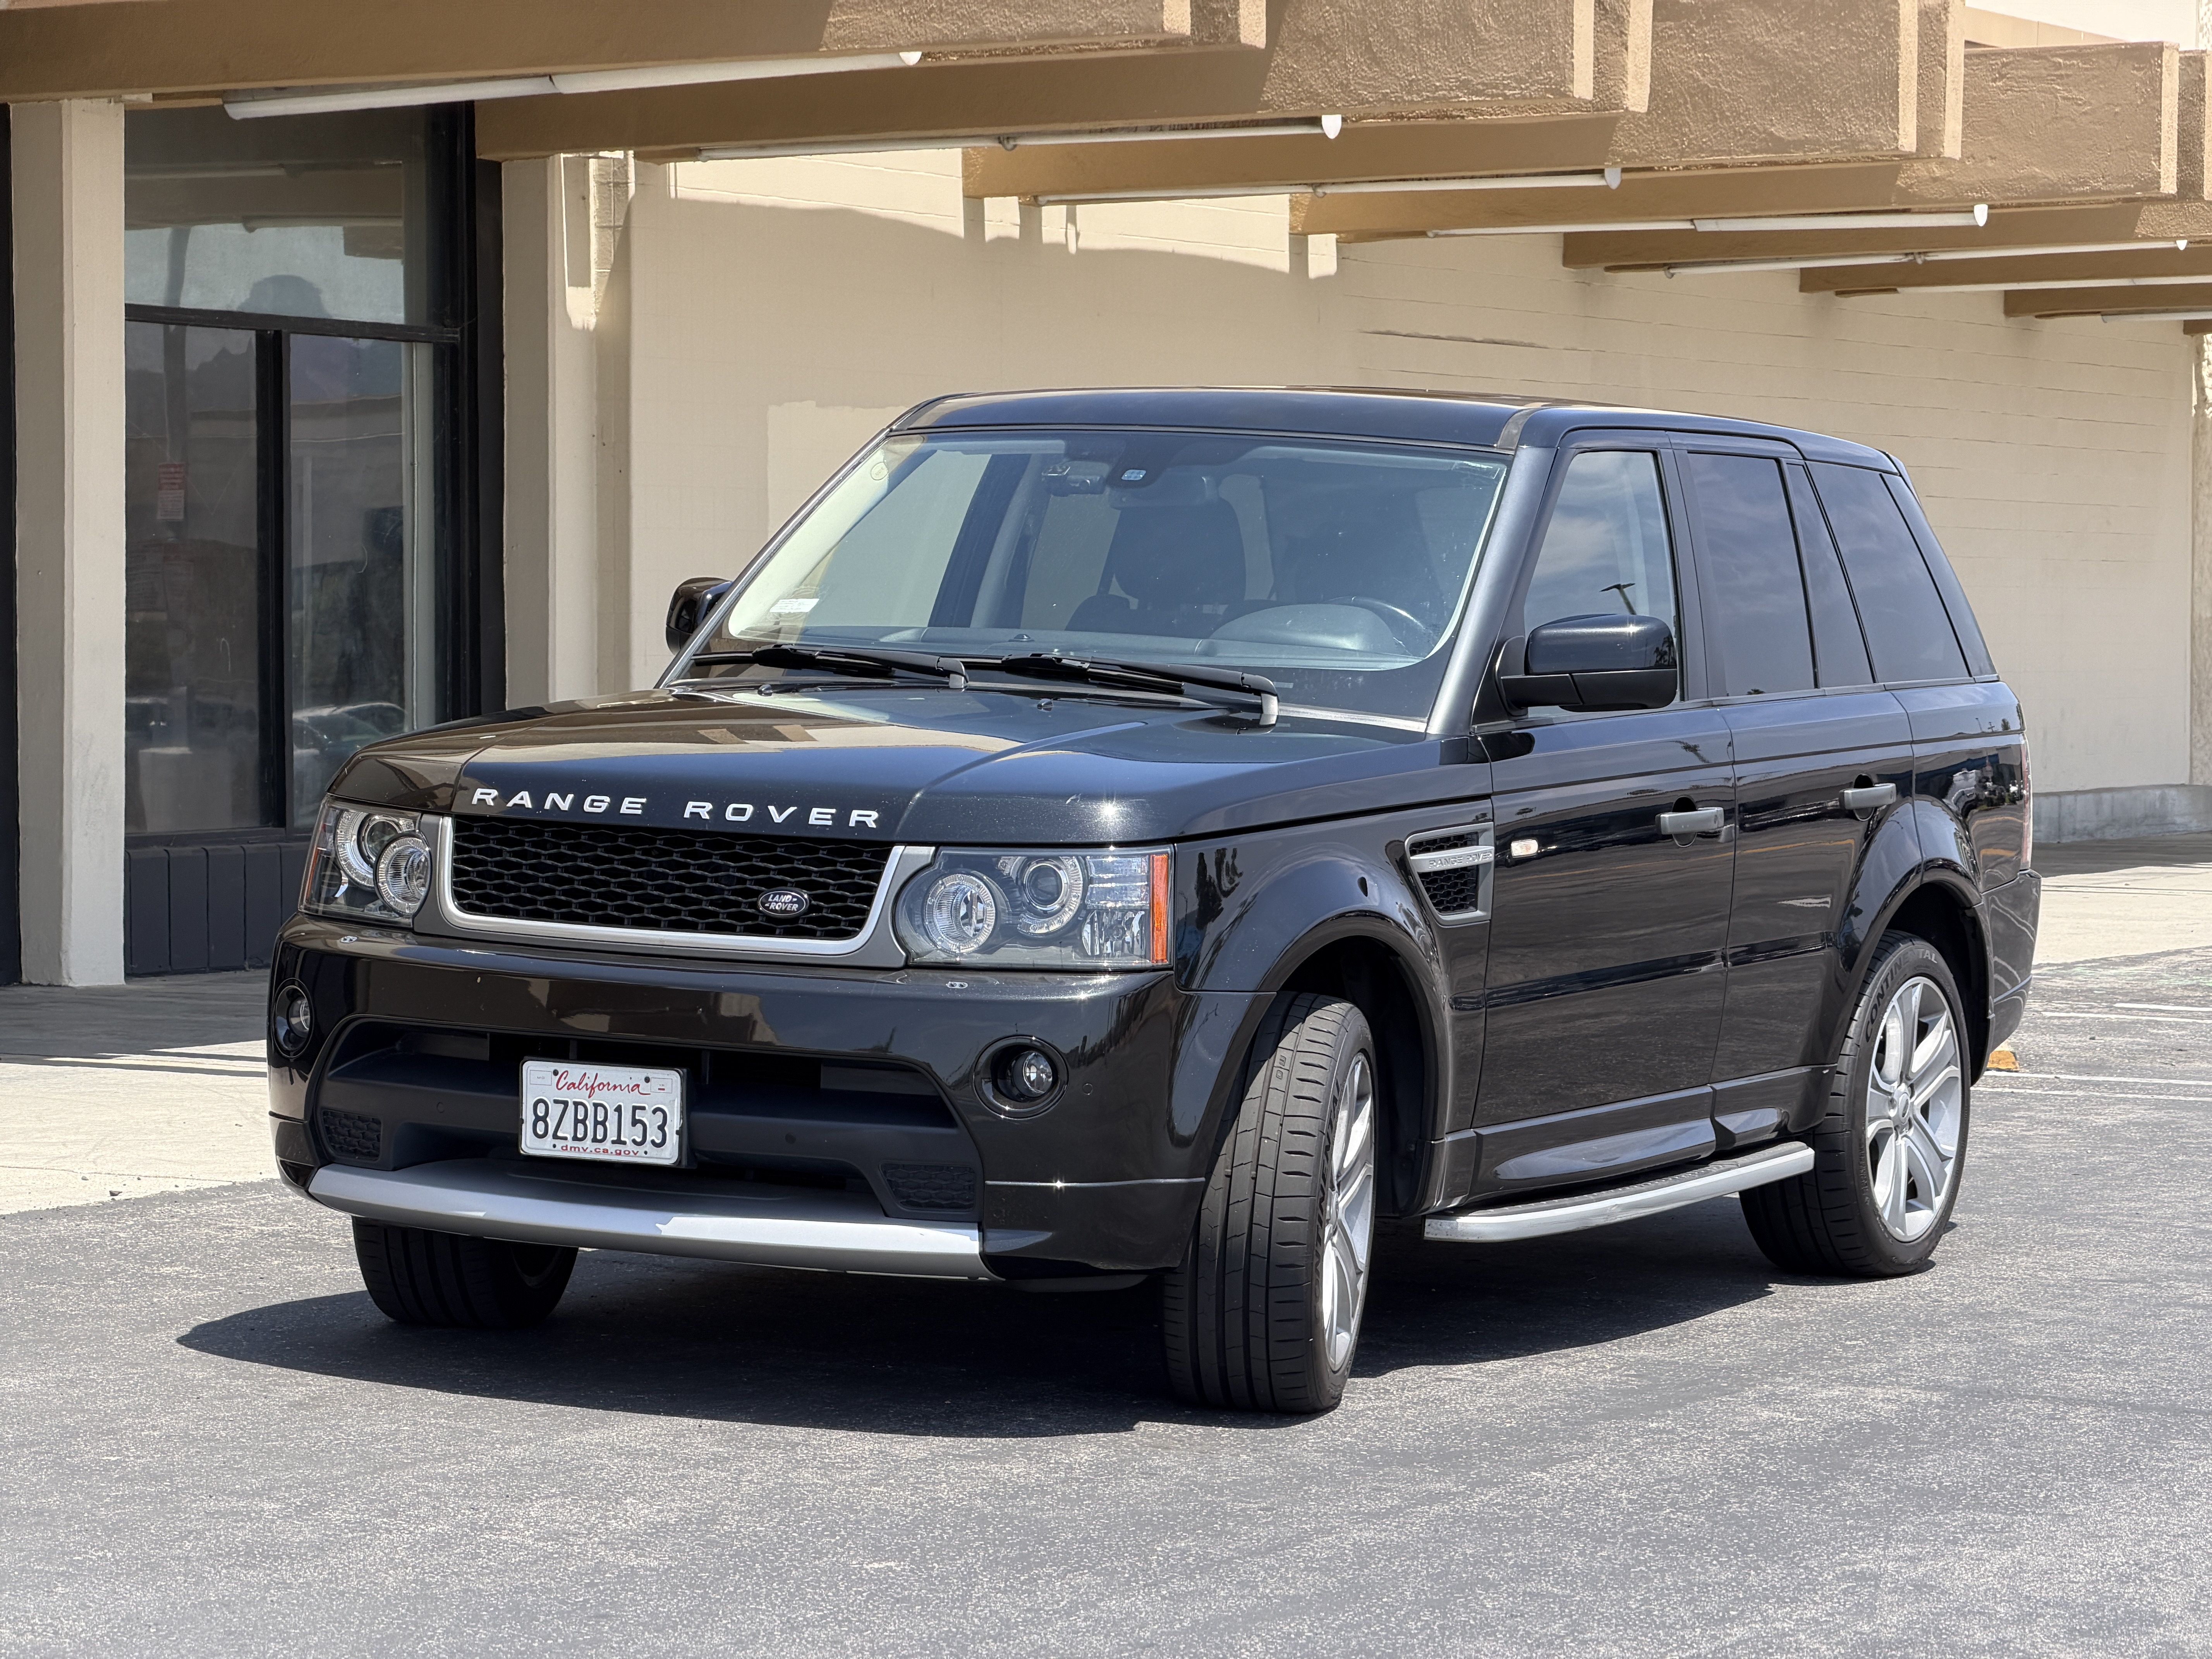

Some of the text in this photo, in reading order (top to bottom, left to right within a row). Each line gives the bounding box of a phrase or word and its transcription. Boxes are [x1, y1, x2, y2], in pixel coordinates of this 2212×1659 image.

[472, 788, 879, 828] RANGE ROVER
[1429, 851, 1493, 868] RANGE ROVER
[768, 894, 792, 902] LAND
[769, 902, 799, 911] ROVER
[1865, 949, 1937, 1043] CONTINENTAL
[556, 1070, 651, 1099] California
[532, 1099, 668, 1148] 8ZBB153
[561, 1145, 639, 1156] dmv.ca.gov
[1314, 1079, 1340, 1319] CONTINENTAL
